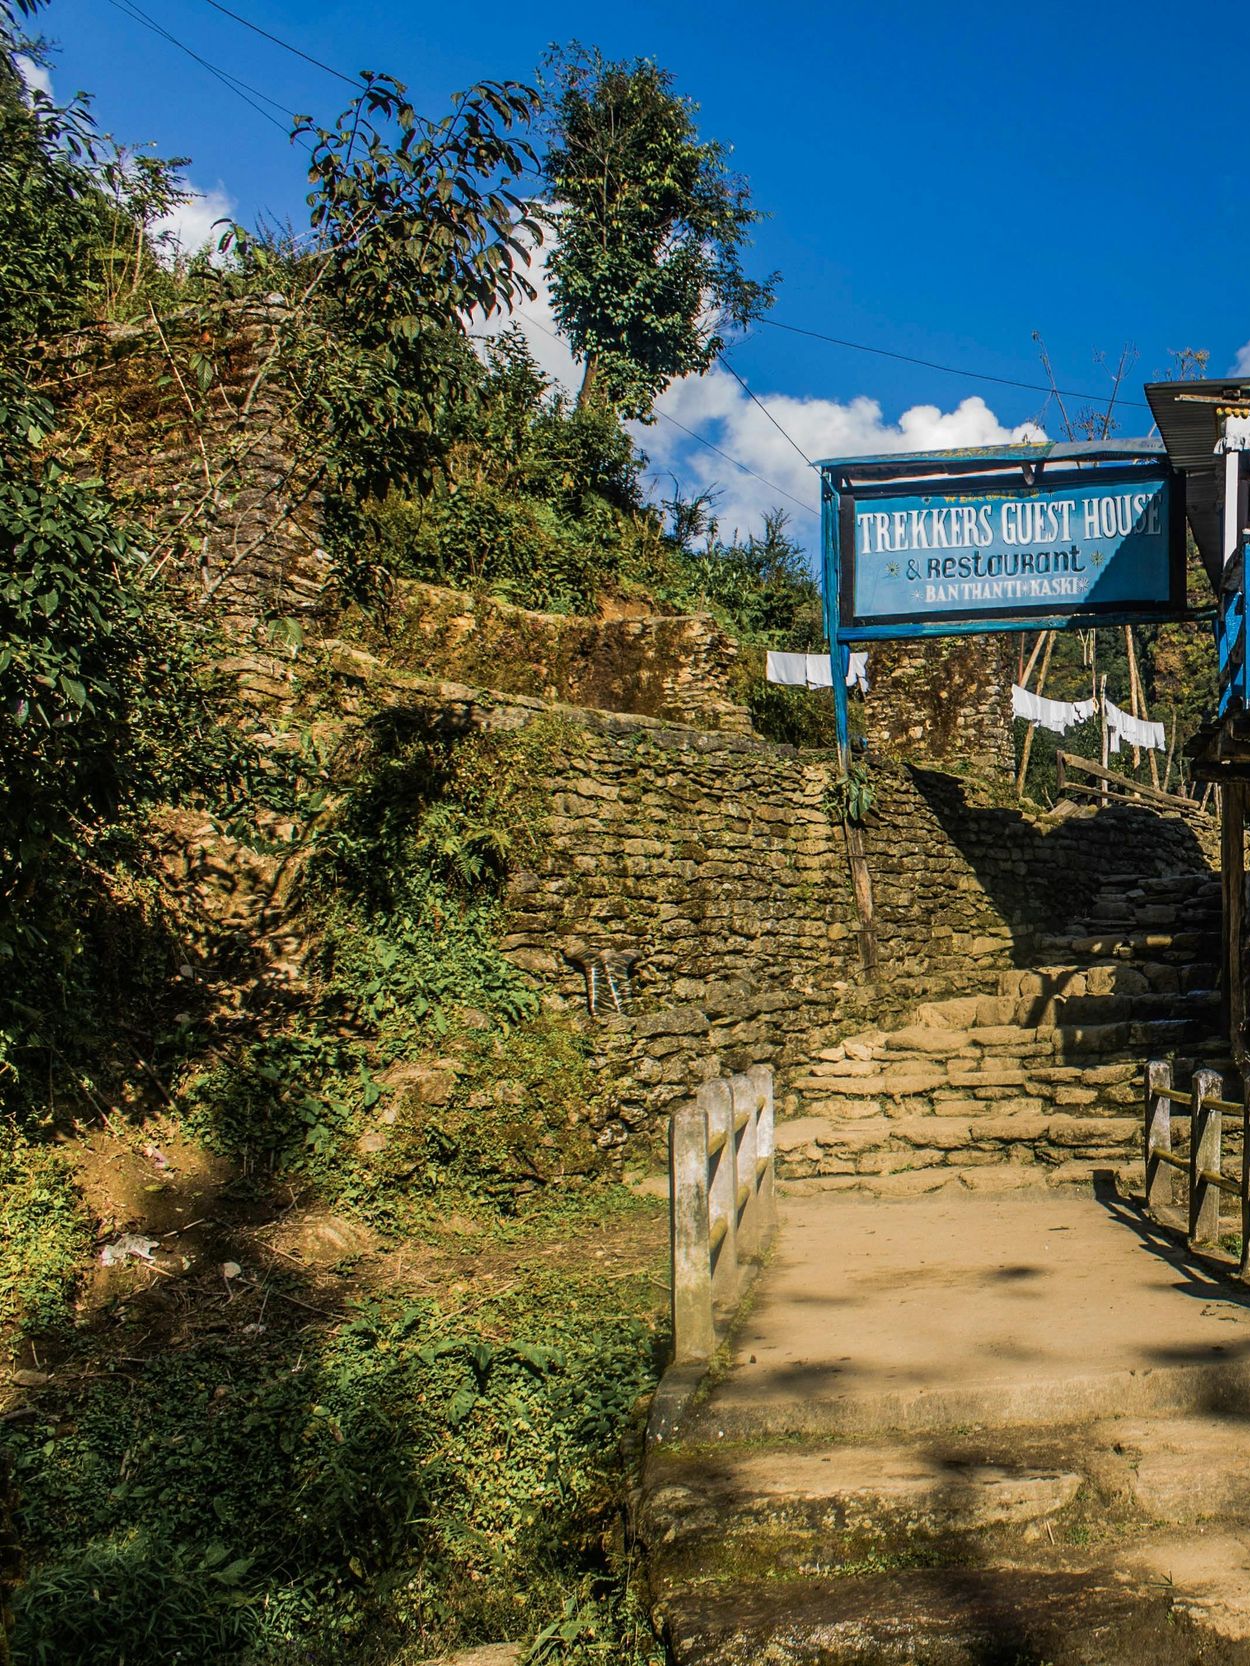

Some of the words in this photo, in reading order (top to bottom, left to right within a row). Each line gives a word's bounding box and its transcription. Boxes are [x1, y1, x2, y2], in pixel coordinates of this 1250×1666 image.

[857, 503, 993, 554] TREKKERS
[1001, 500, 1076, 544] GUEST
[1082, 493, 1163, 541] HOUSE
[906, 558, 921, 580] &
[1030, 577, 1077, 597] KASKI
